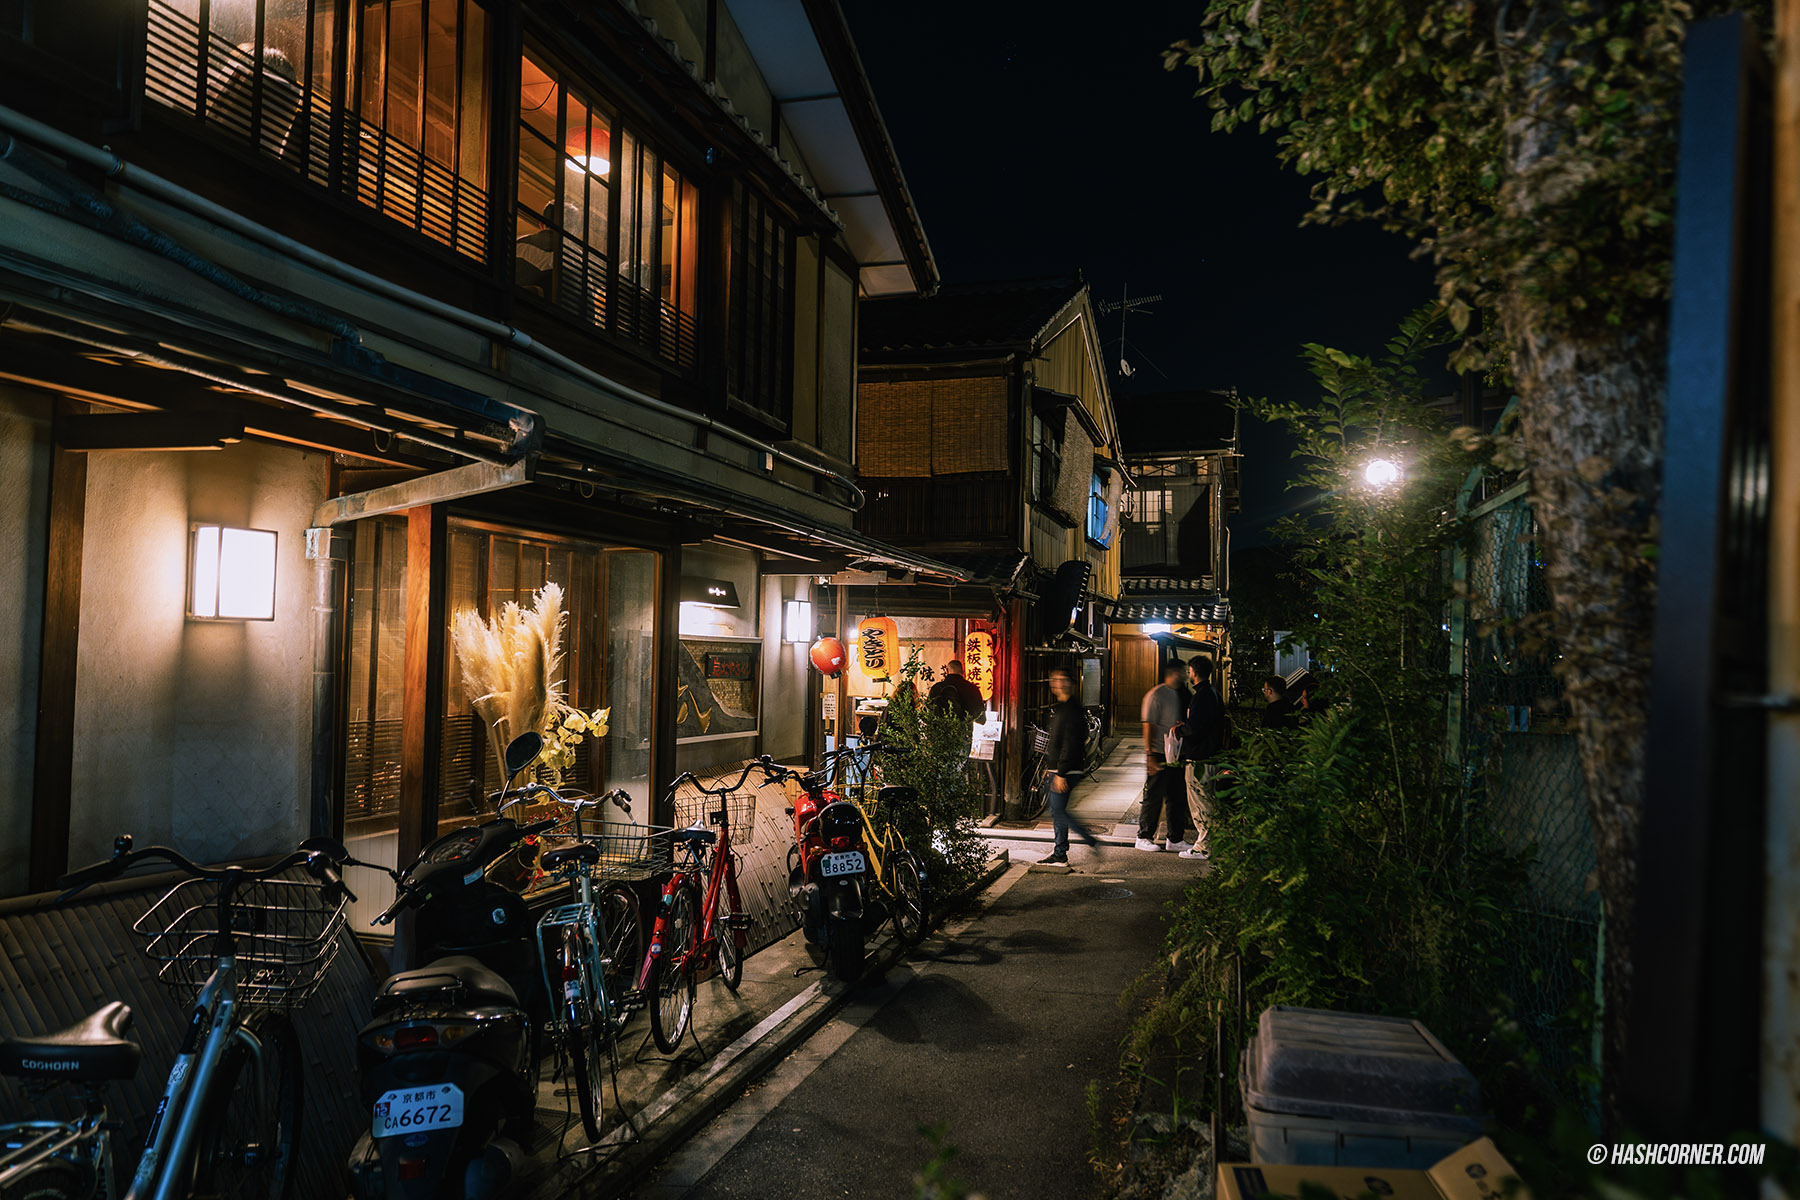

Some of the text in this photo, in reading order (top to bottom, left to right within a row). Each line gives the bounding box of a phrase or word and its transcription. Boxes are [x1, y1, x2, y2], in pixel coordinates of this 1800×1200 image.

[861, 628, 886, 669] やきとり
[966, 637, 982, 688] 鉄板焼
[825, 859, 863, 874] B8852
[402, 1090, 436, 1104] 京都市
[384, 1104, 451, 1129] CA6672
